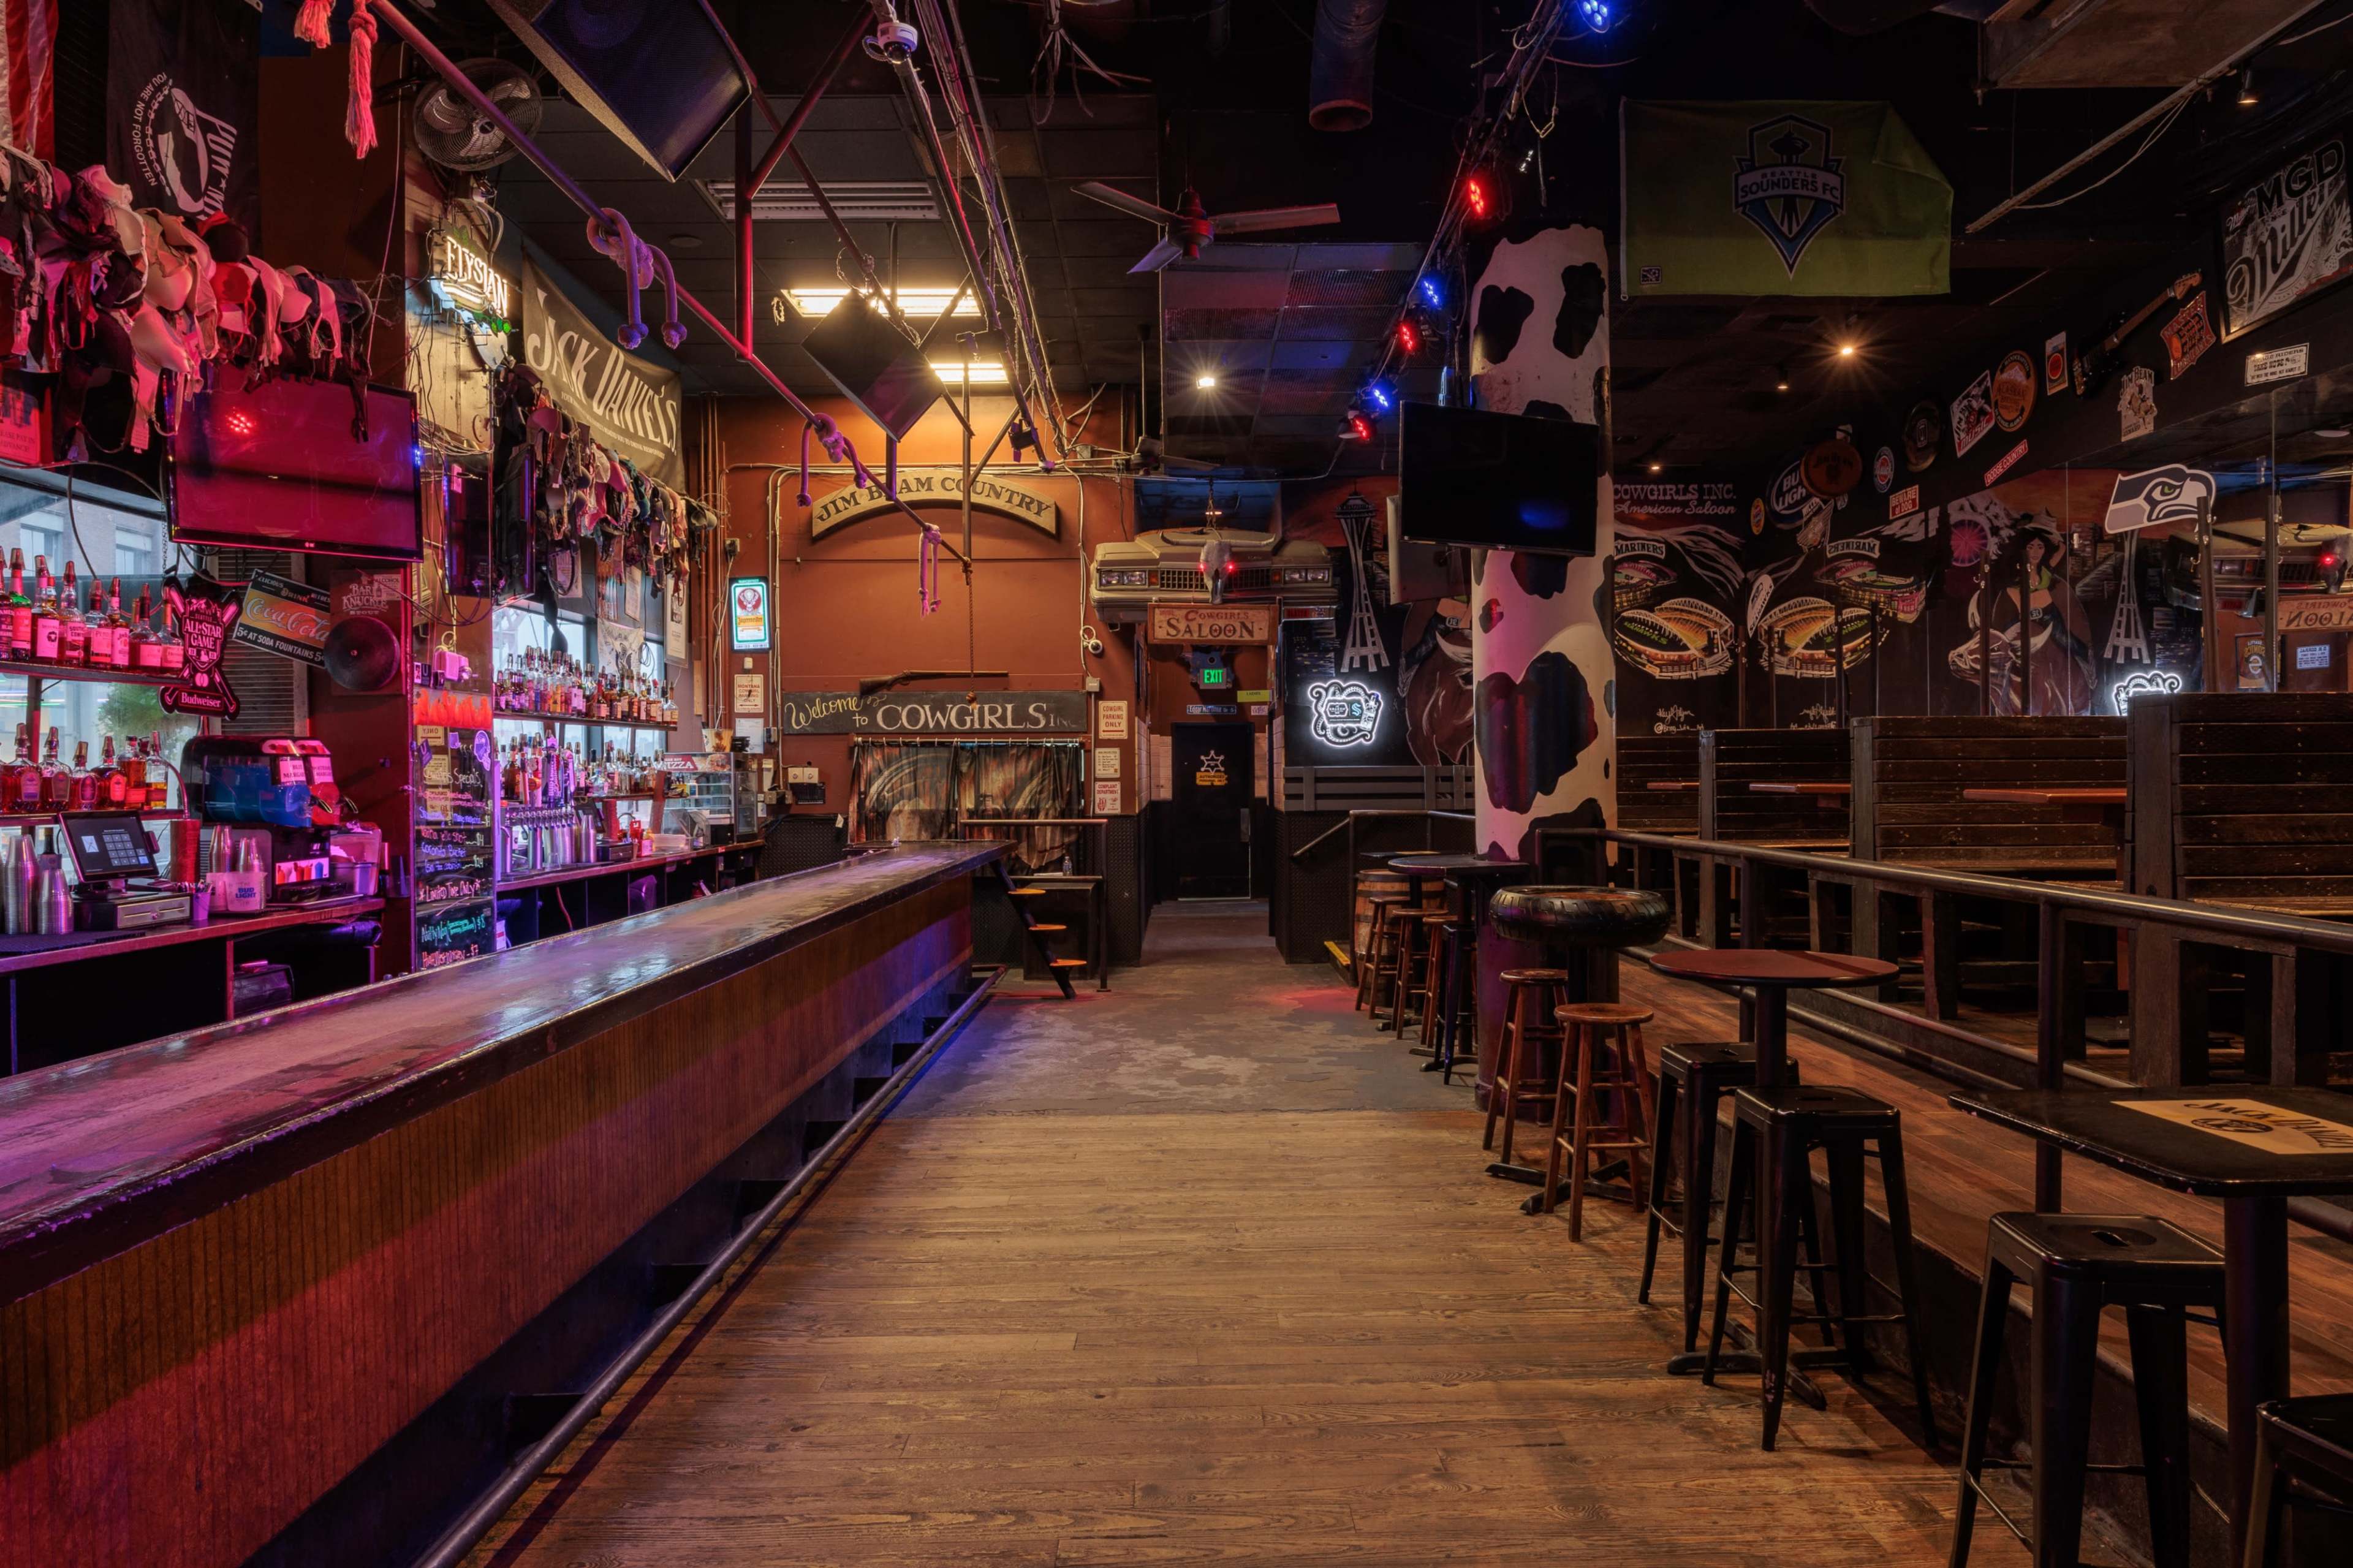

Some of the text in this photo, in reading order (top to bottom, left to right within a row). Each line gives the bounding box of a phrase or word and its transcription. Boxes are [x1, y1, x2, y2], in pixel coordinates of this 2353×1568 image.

[132, 72, 167, 186] YOU ARE NOT FORGOTTEN
[1761, 170, 1818, 180] SEATTLE
[2254, 140, 2345, 216] MGD
[1740, 178, 1840, 200] SOUNDERS FC
[442, 235, 509, 319] ELYSIAN
[527, 288, 677, 456] JACK DANIEL'S
[1986, 442, 2026, 483] DODGE COUNTRY
[1614, 483, 1737, 500] COWGIRLS INC.
[1783, 471, 1800, 492] BU
[816, 476, 1052, 522] JIM BAM COUNTRY
[1615, 500, 1737, 515] American Saloon
[1778, 486, 1808, 512] LIGH
[1892, 489, 1916, 507] BEWARE
[1901, 501, 1912, 513] DOG
[1615, 542, 1664, 555] MARINERS
[281, 588, 309, 603] DRINK
[350, 583, 374, 596] BAR
[343, 596, 388, 610] KNUCKLE
[247, 597, 330, 641] Coca-Cola
[1185, 609, 1249, 621] COWGIRLS
[1166, 617, 1255, 638] SALOON
[191, 633, 215, 650] GAME
[248, 633, 258, 642] AT
[257, 635, 274, 646] SODA
[275, 641, 314, 659] FOUNTAINS
[1204, 670, 1223, 683] EXIT
[181, 692, 221, 707] Budweiser
[785, 695, 861, 730] Welcome
[852, 714, 868, 728] to
[876, 702, 1047, 730] COWGIRLS
[2183, 1102, 2290, 1121] JACK
